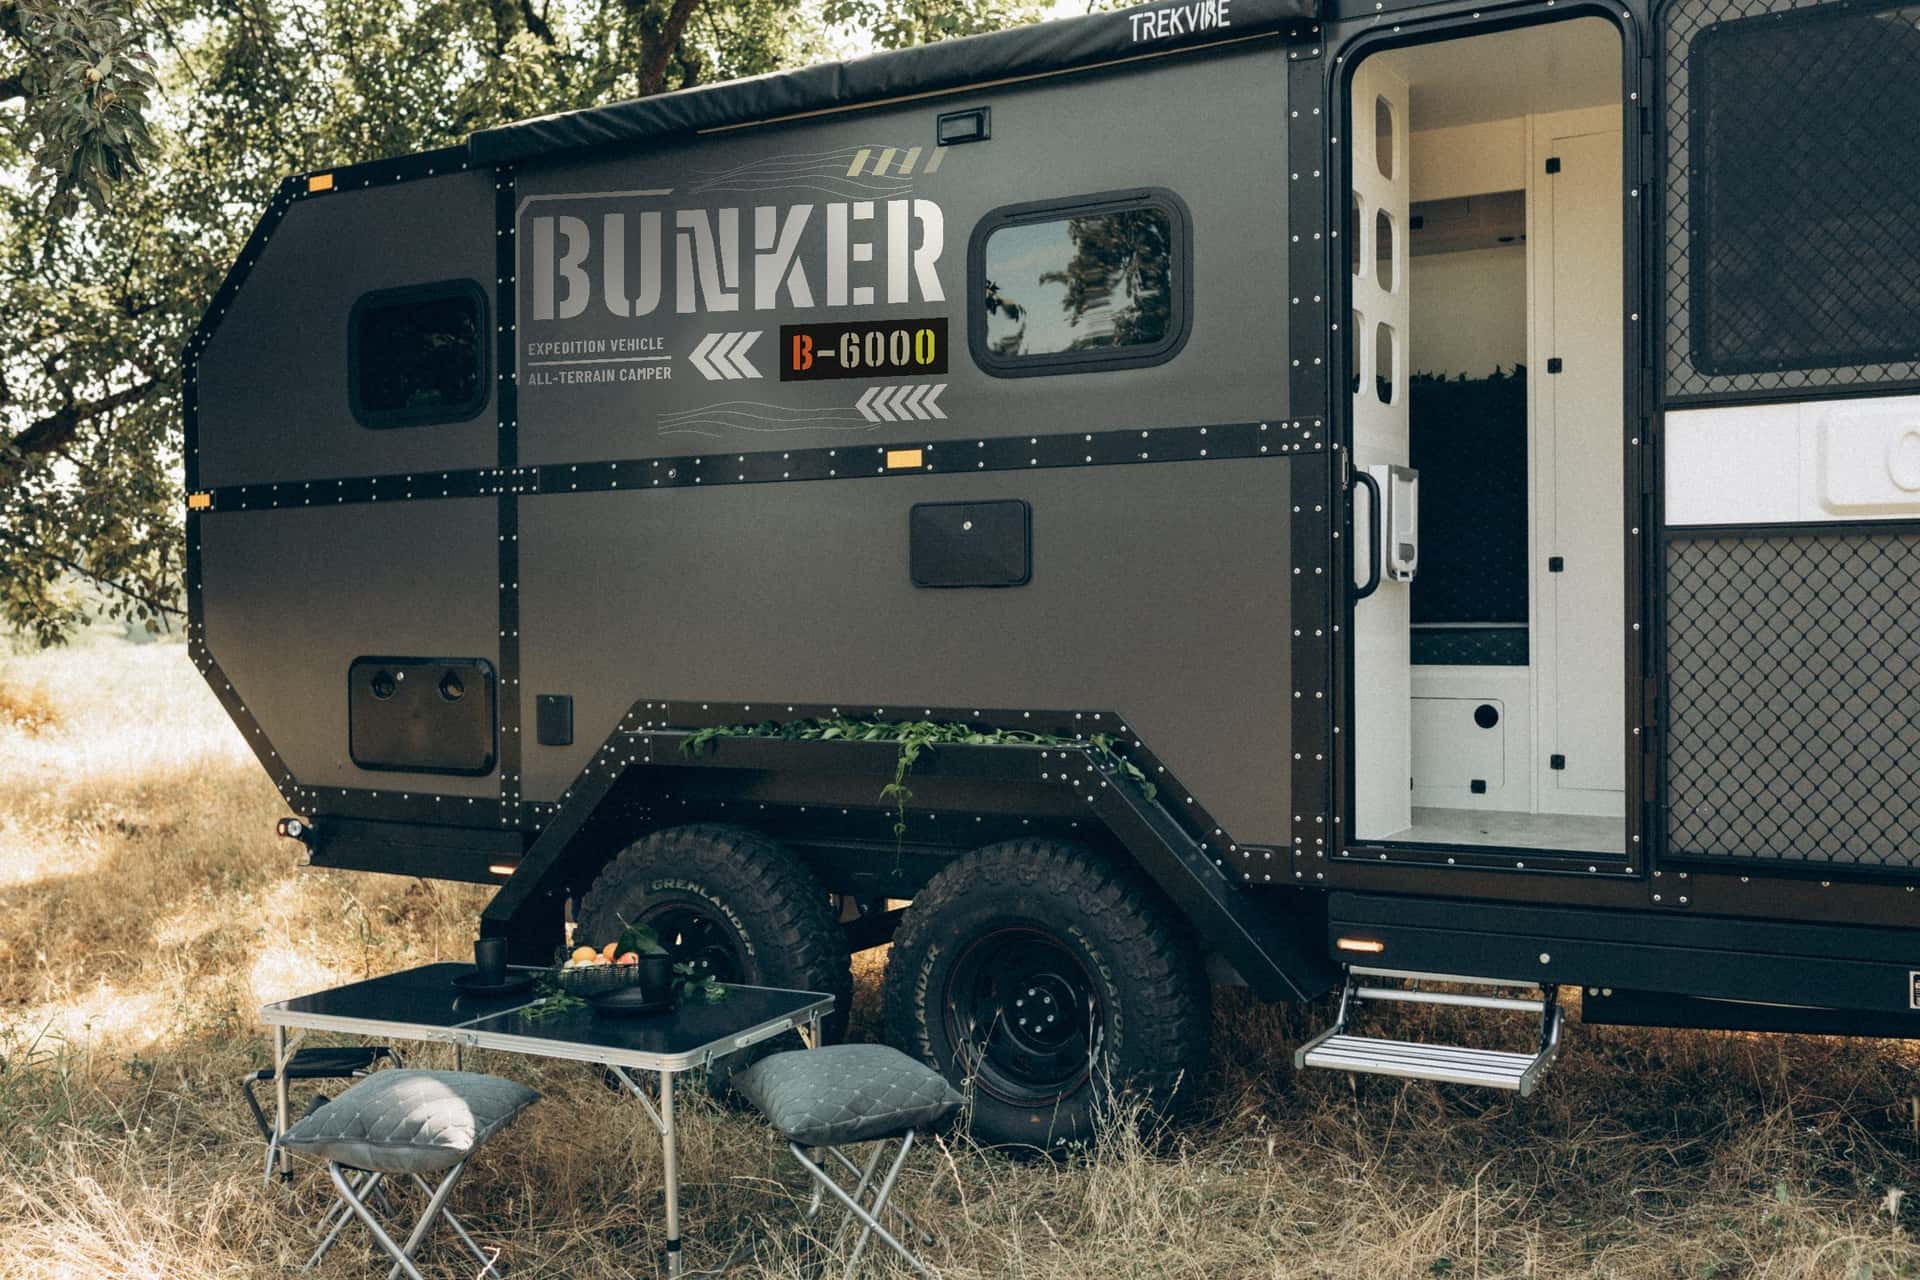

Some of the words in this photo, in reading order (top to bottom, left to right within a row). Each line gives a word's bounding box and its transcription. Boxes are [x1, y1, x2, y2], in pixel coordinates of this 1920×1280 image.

[533, 199, 946, 321] BUNKER
[528, 340, 606, 356] EXPEDITION
[610, 337, 665, 352] VEHICLE
[528, 369, 616, 386] ALL-TERRAIN
[619, 366, 672, 382] CAMPER
[792, 328, 936, 371] B-6000
[652, 879, 755, 956] GRENLANDER
[914, 944, 944, 1072] ENLANDER
